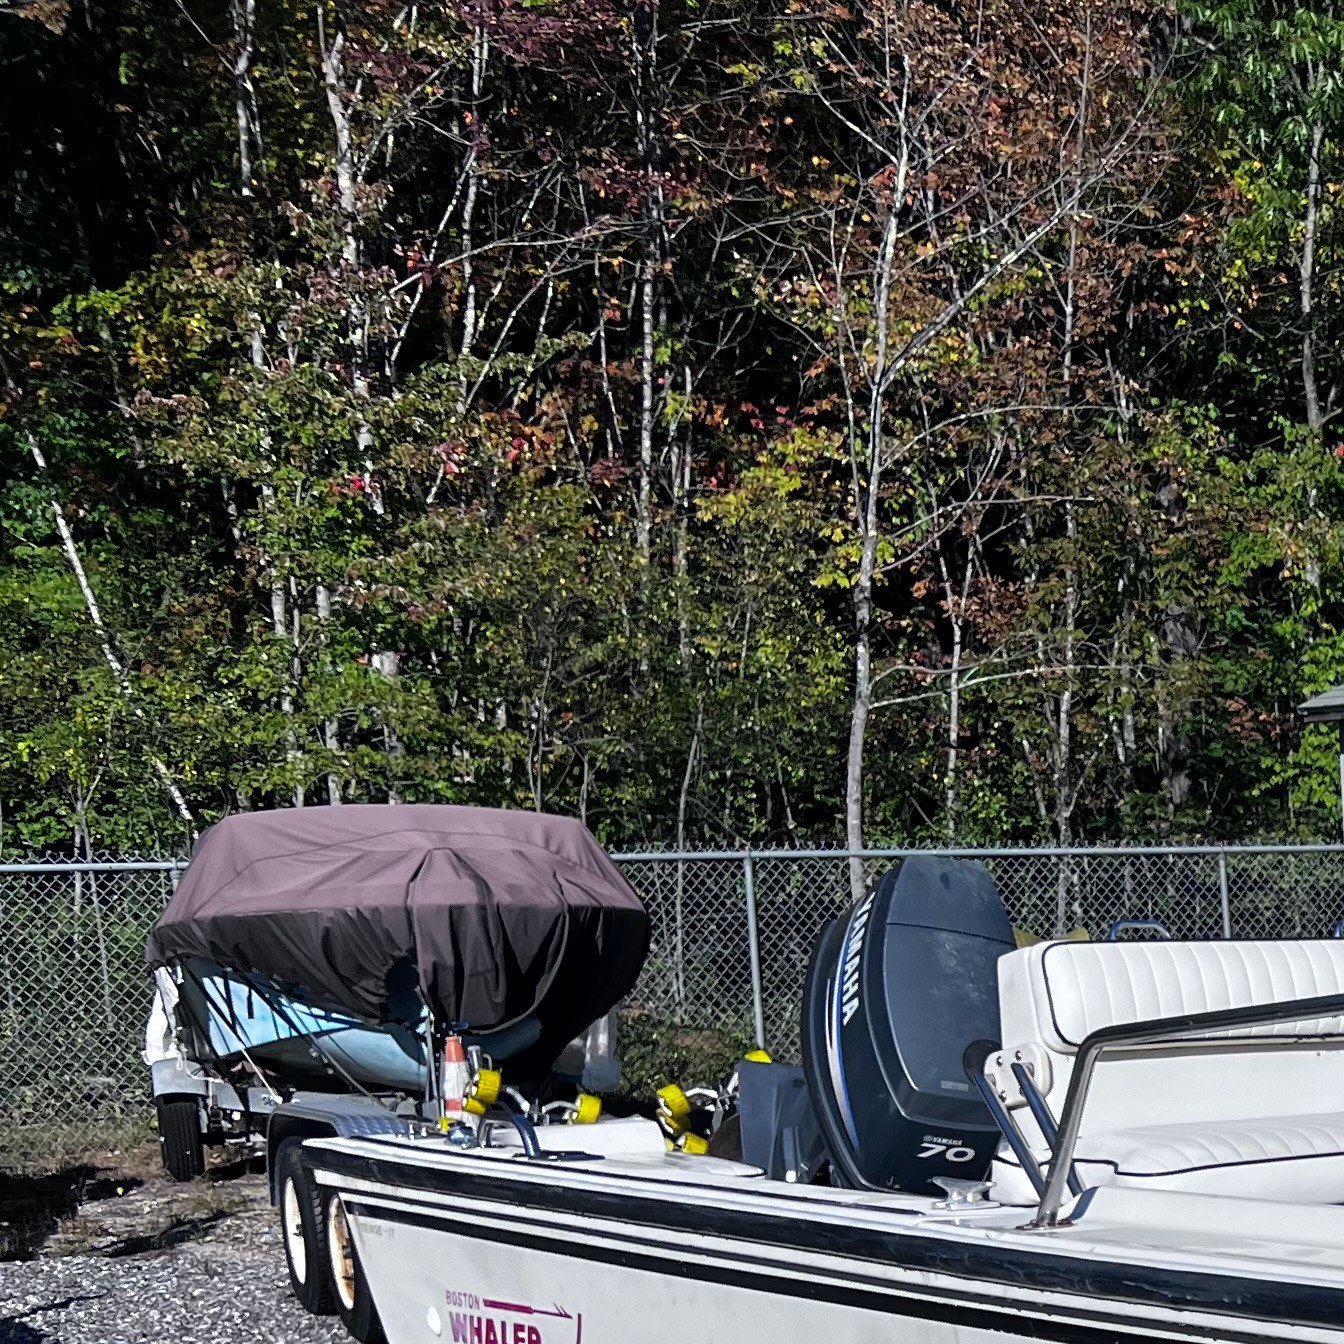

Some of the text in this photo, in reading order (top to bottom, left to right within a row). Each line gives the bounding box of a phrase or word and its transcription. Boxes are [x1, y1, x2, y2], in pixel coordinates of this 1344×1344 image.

[842, 891, 876, 1026] YAMAHA
[916, 1143, 976, 1162] 70
[446, 1290, 480, 1310] BOSTON
